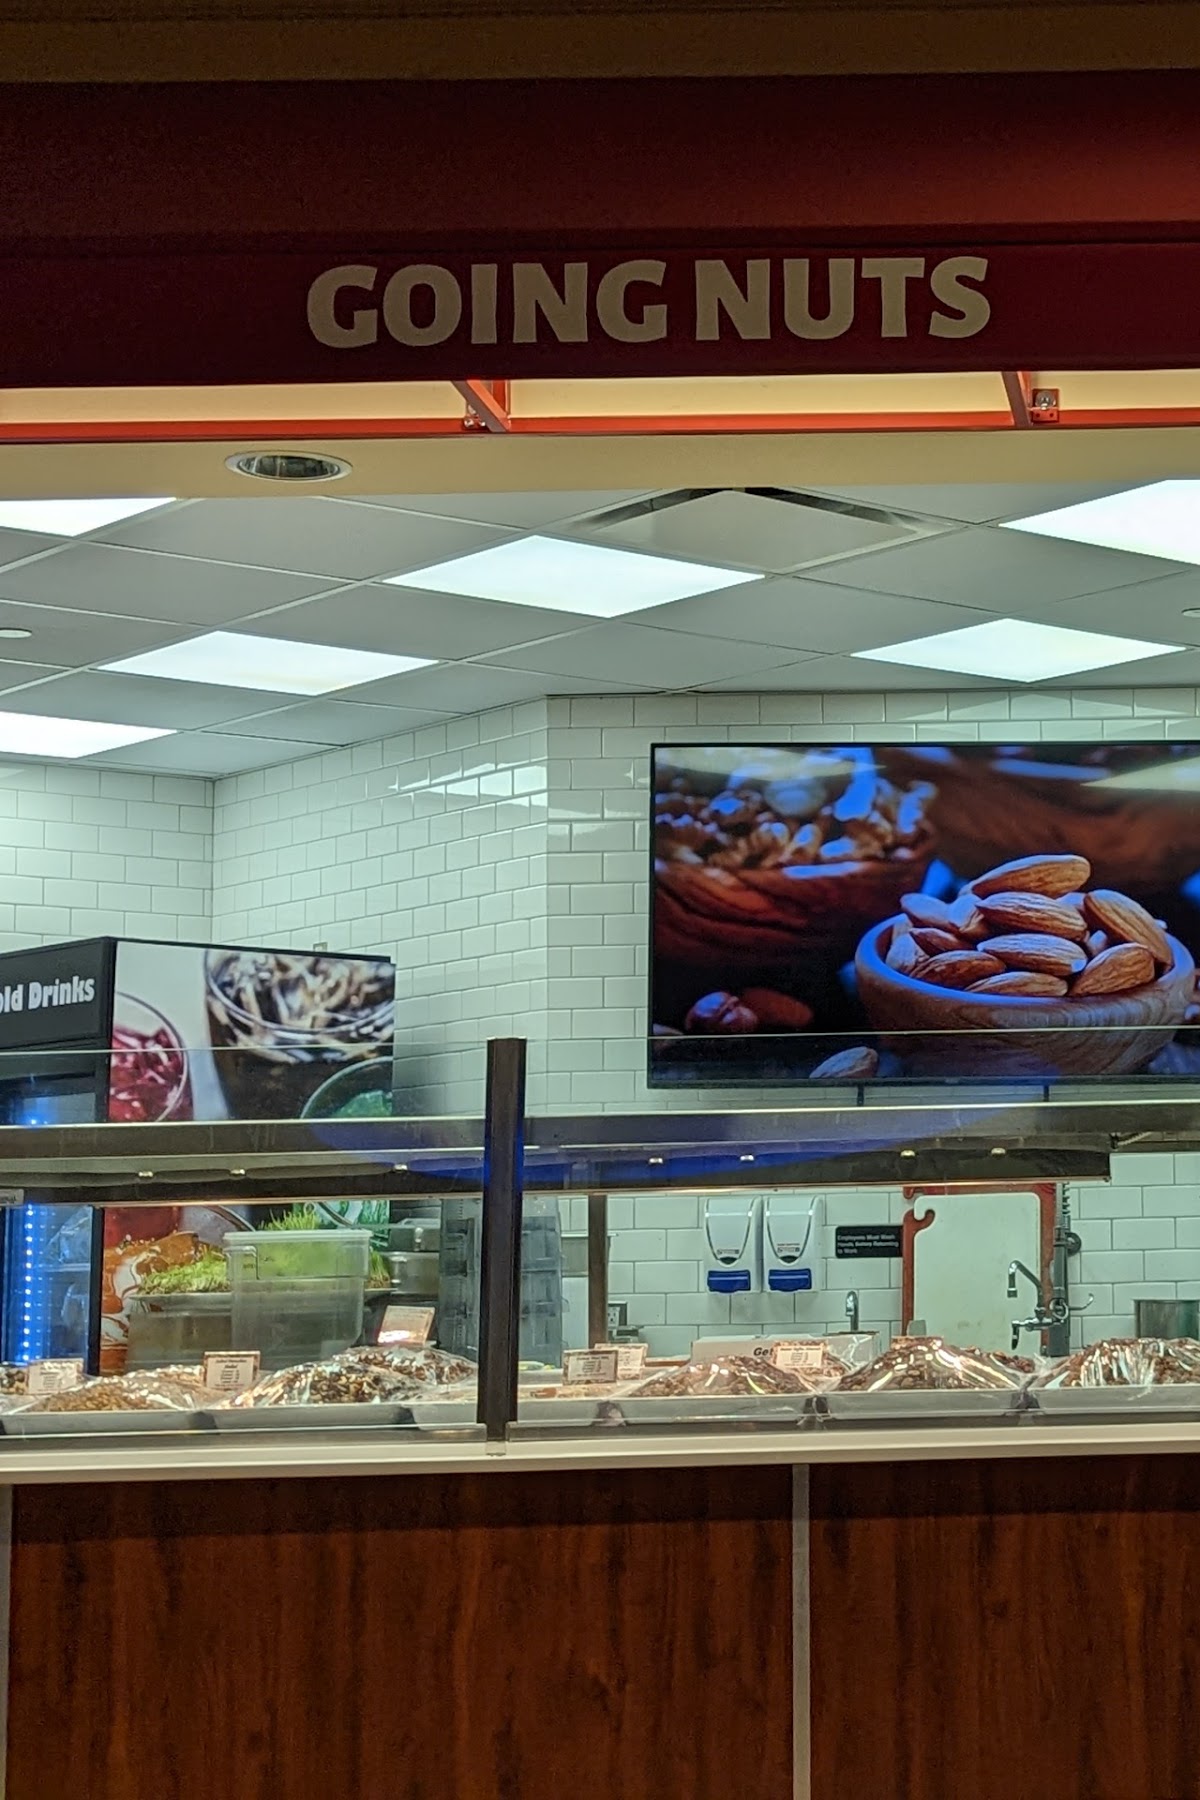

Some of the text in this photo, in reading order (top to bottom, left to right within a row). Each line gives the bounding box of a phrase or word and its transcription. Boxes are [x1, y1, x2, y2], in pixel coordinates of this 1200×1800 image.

[307, 255, 991, 349] GOING NUTS
[28, 975, 95, 1010] Drinks
